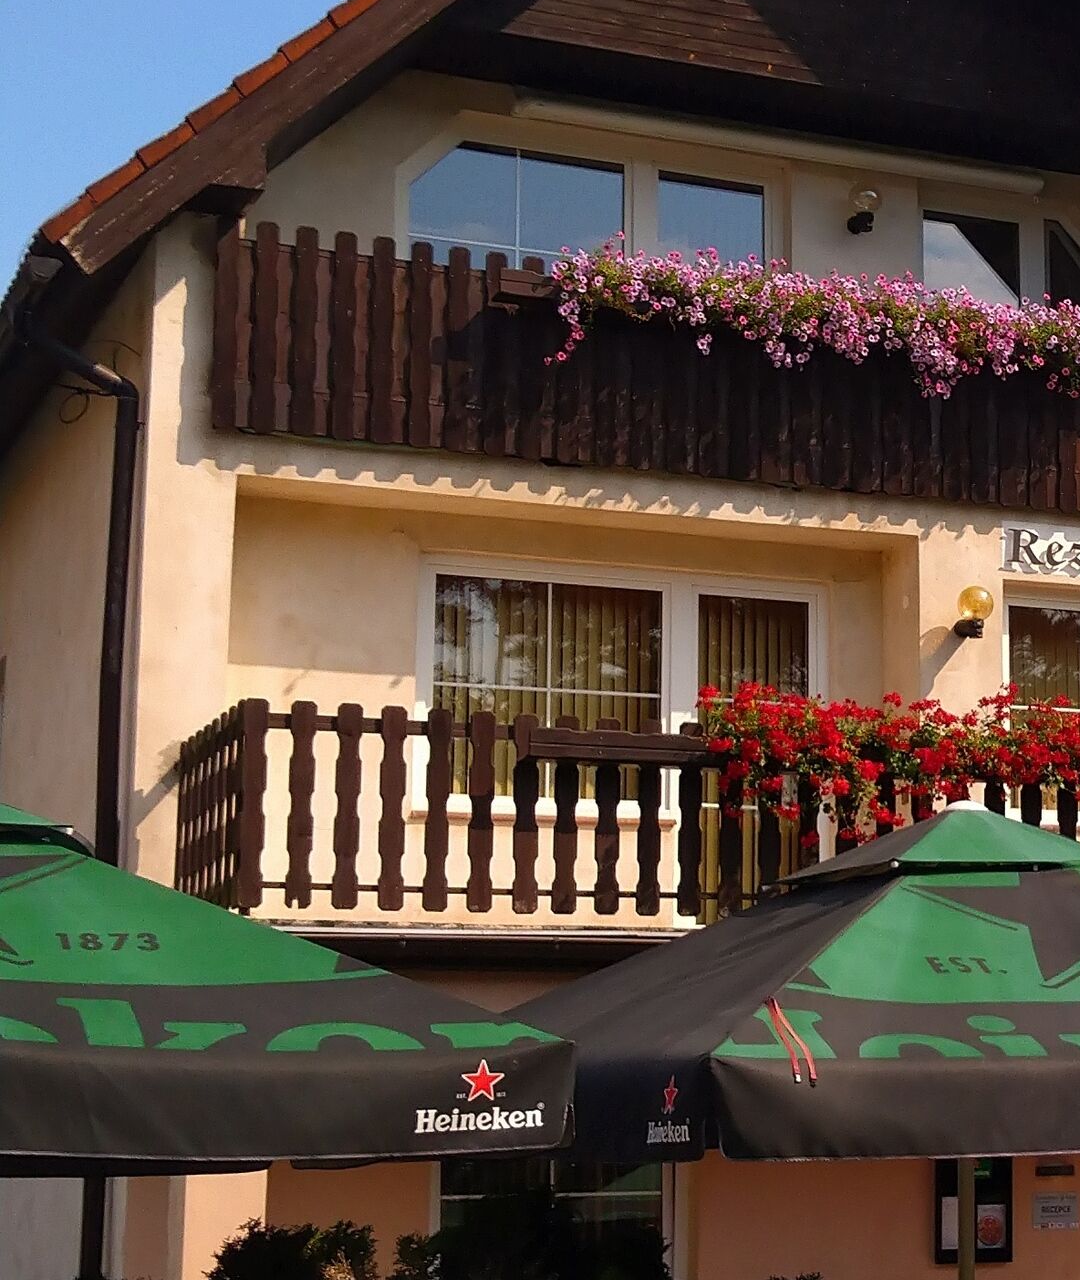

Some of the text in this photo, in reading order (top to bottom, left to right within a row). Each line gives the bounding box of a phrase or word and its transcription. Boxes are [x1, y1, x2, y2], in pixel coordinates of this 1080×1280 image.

[55, 932, 160, 952] 1873
[926, 955, 1008, 975] EST.
[415, 1106, 544, 1134] Heineken
